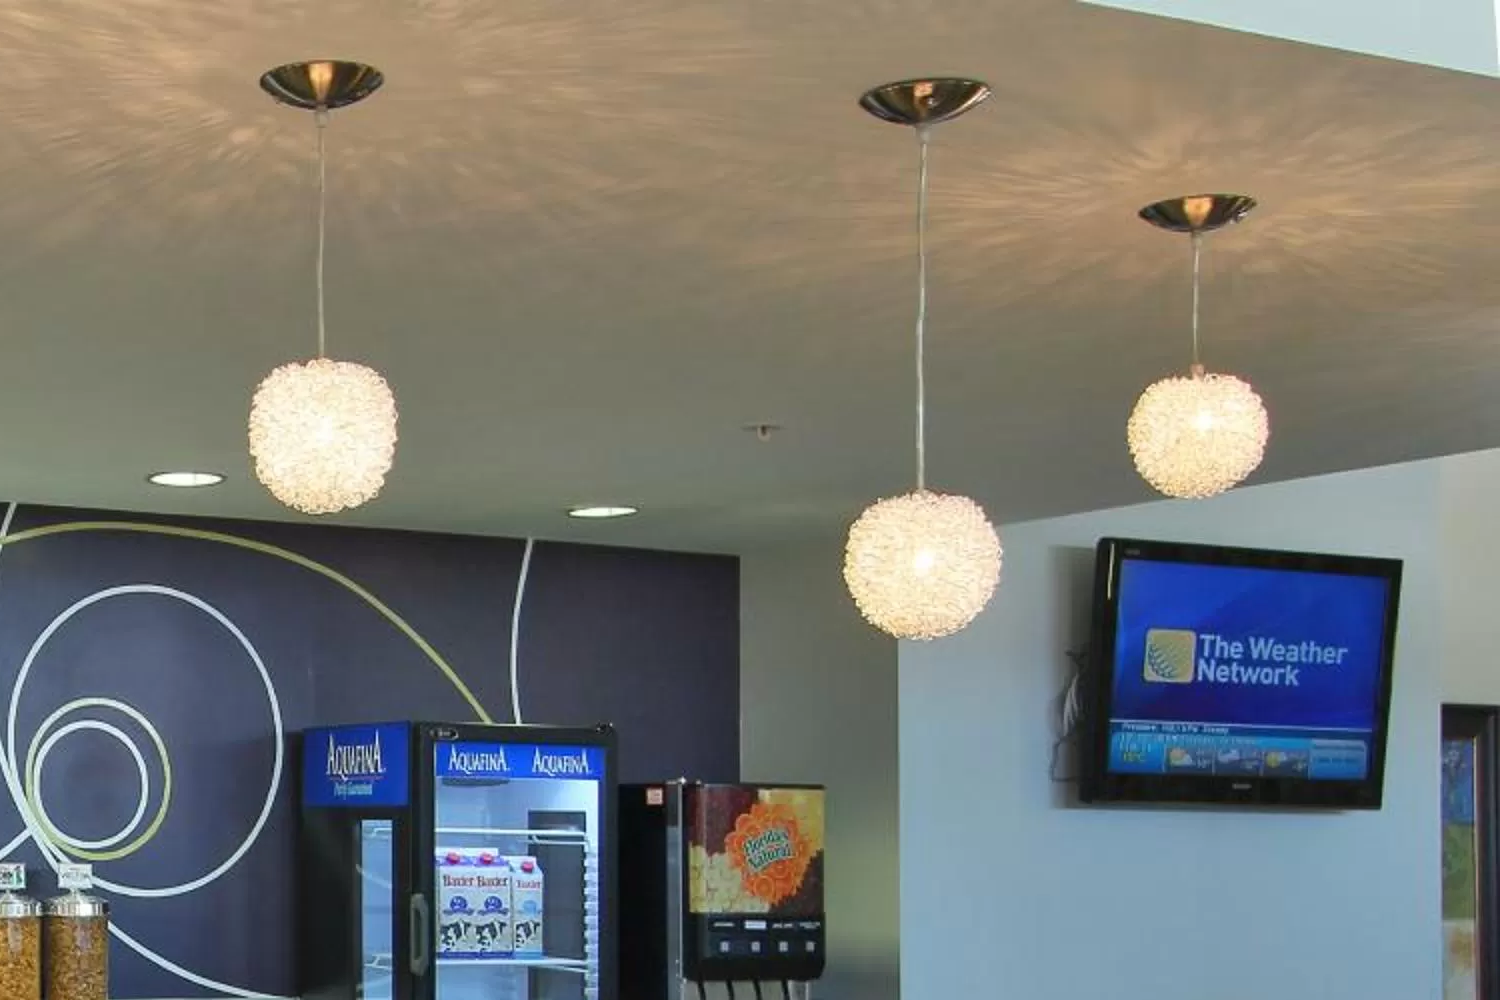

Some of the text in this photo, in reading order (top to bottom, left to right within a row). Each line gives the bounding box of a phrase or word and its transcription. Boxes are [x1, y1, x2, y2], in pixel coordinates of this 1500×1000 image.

[1199, 634, 1348, 664] The Weather
[1198, 658, 1300, 686] Network
[326, 732, 382, 780] AQUAFINA
[448, 744, 508, 774] AQUAFINA
[532, 746, 590, 776] AQUAFINA
